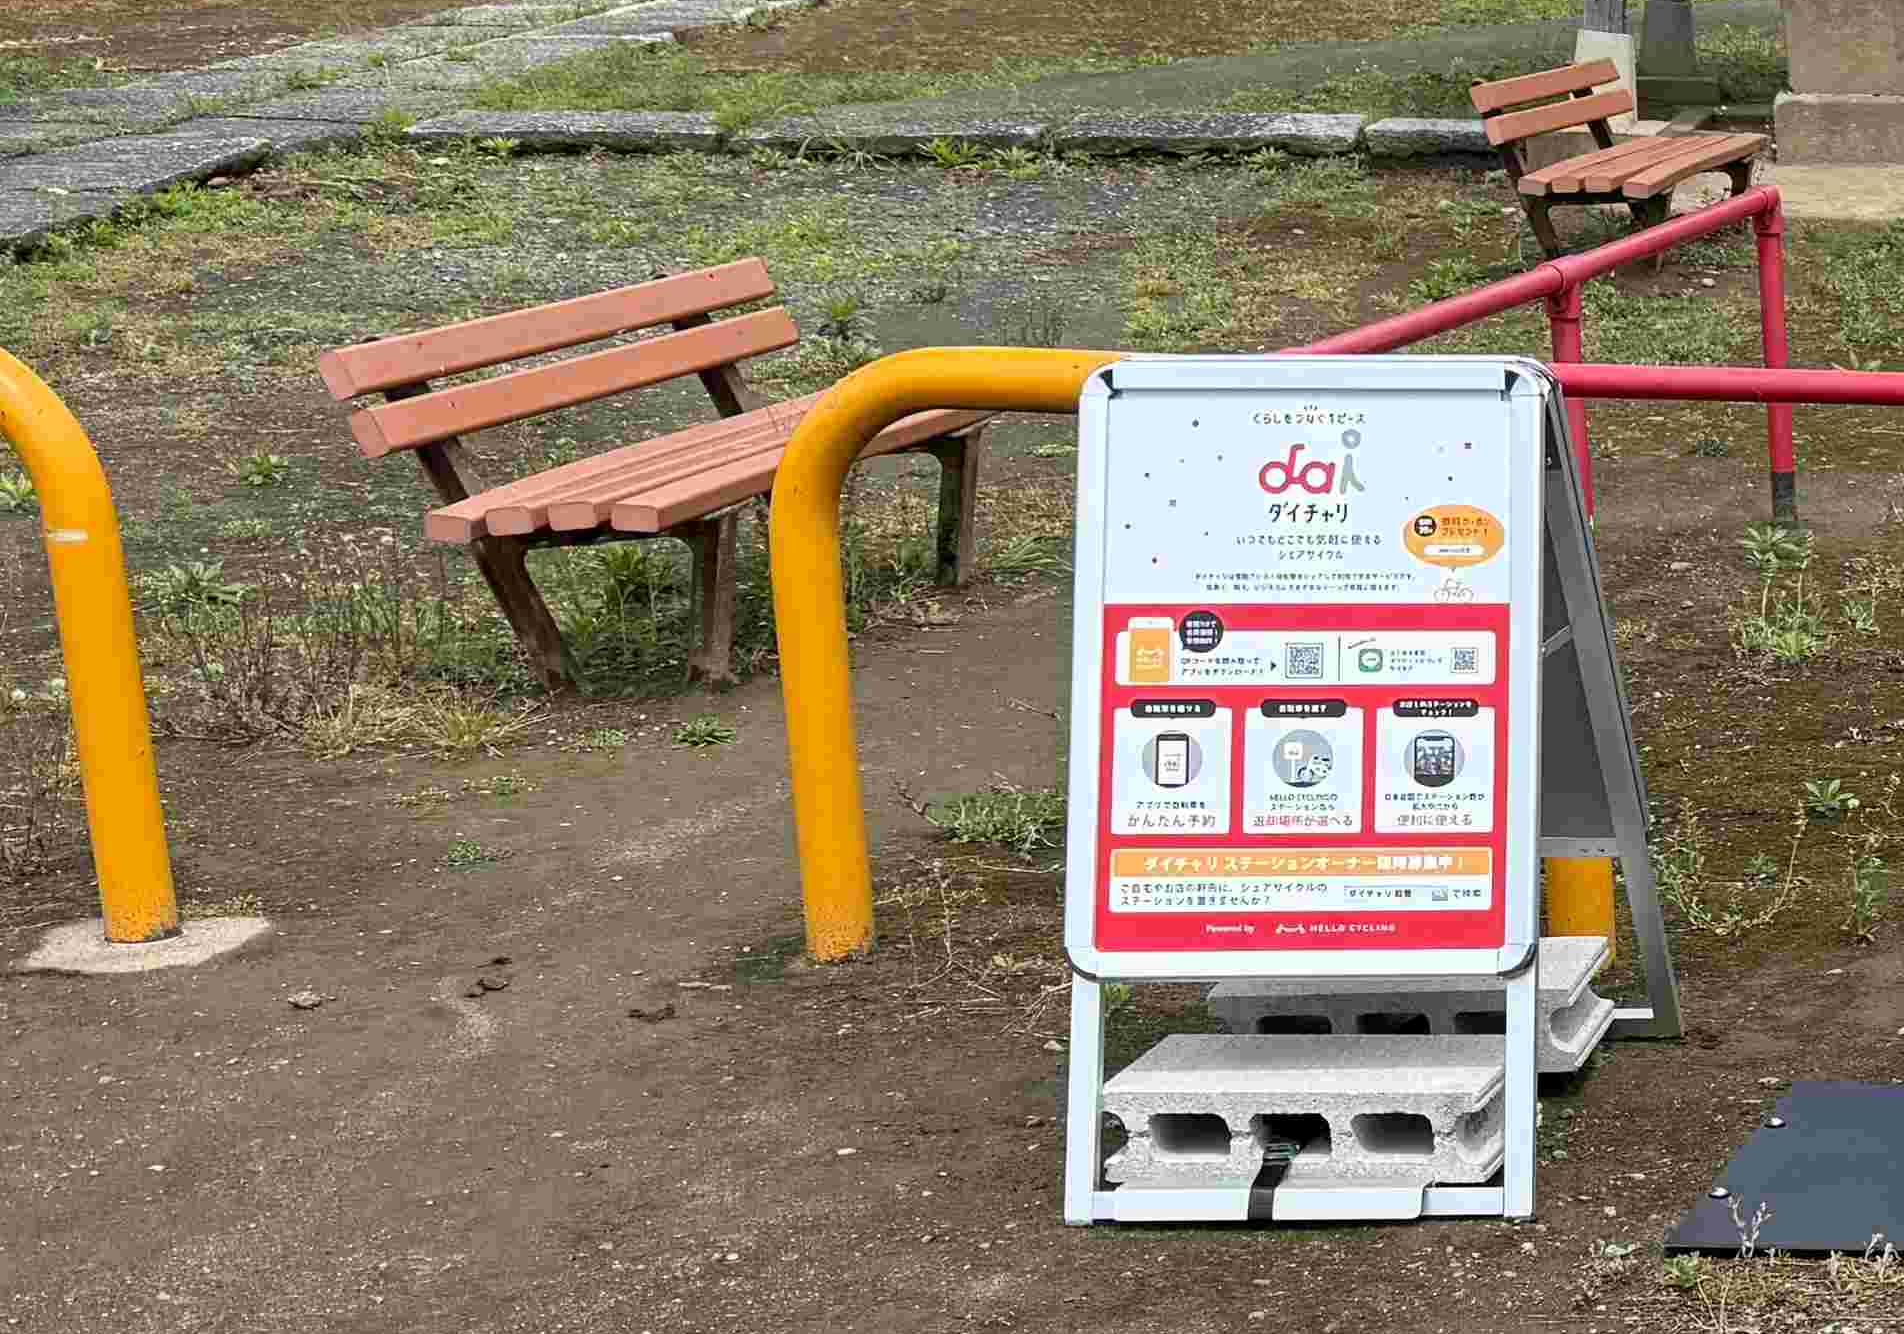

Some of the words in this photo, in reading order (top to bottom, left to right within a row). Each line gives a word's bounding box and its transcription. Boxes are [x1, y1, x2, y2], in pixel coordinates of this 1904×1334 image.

[1268, 501, 1349, 524] ダイチャリ
[1277, 549, 1345, 561] シェアサイクル
[1127, 813, 1216, 828] かんたん予約
